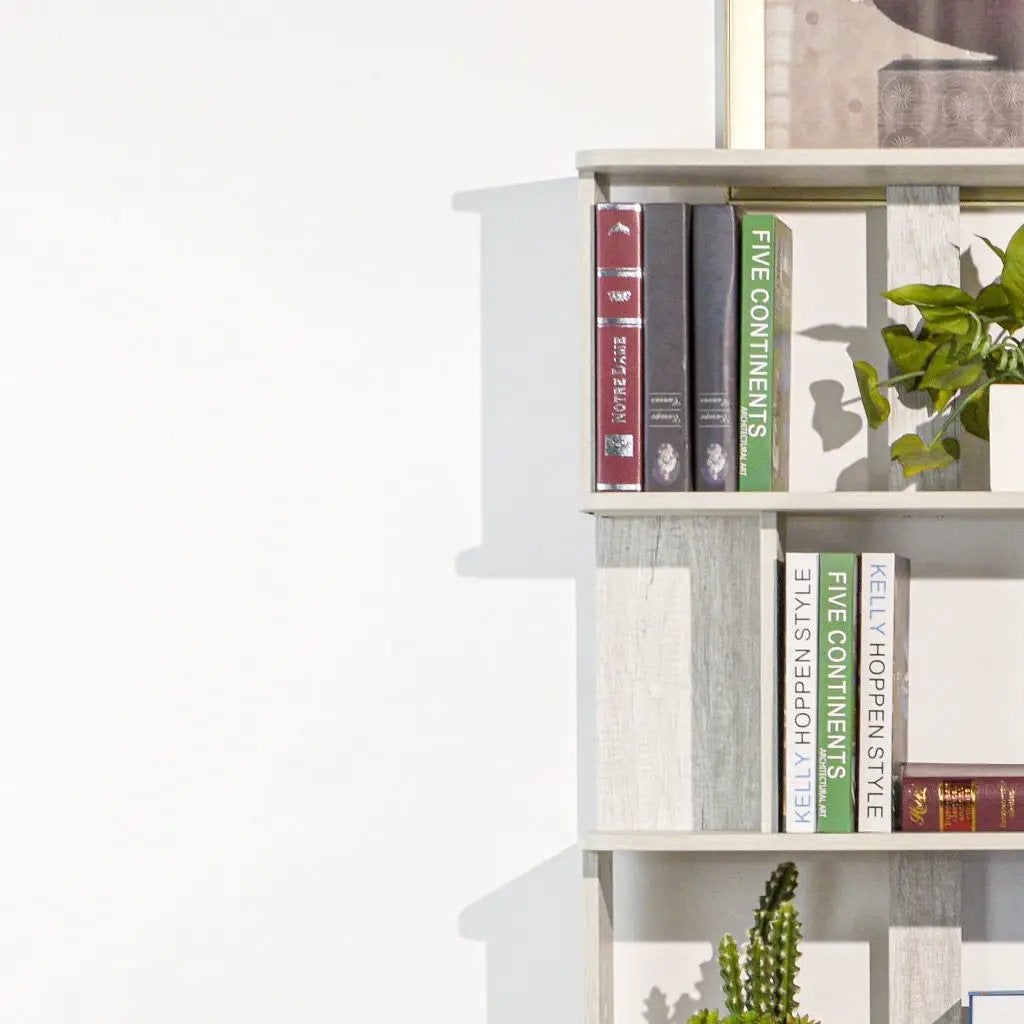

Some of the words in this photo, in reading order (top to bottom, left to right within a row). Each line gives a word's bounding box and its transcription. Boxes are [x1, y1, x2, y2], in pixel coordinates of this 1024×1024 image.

[751, 229, 771, 281] FIVE
[748, 288, 770, 438] CONTINENTS
[611, 378, 628, 424] NOTRE
[740, 405, 748, 461] ARCHITECTURAL
[794, 568, 811, 641] STYLE
[827, 571, 847, 623] FIVE
[869, 564, 887, 636] KELLY
[794, 649, 811, 745] HOPPEN
[826, 629, 847, 779] CONTINENTS
[867, 642, 886, 738] HOPPEN
[794, 752, 811, 824] KELLY
[818, 747, 827, 803] ARCHITECTURAL
[818, 804, 827, 818] ART
[866, 746, 885, 819] STYLE
